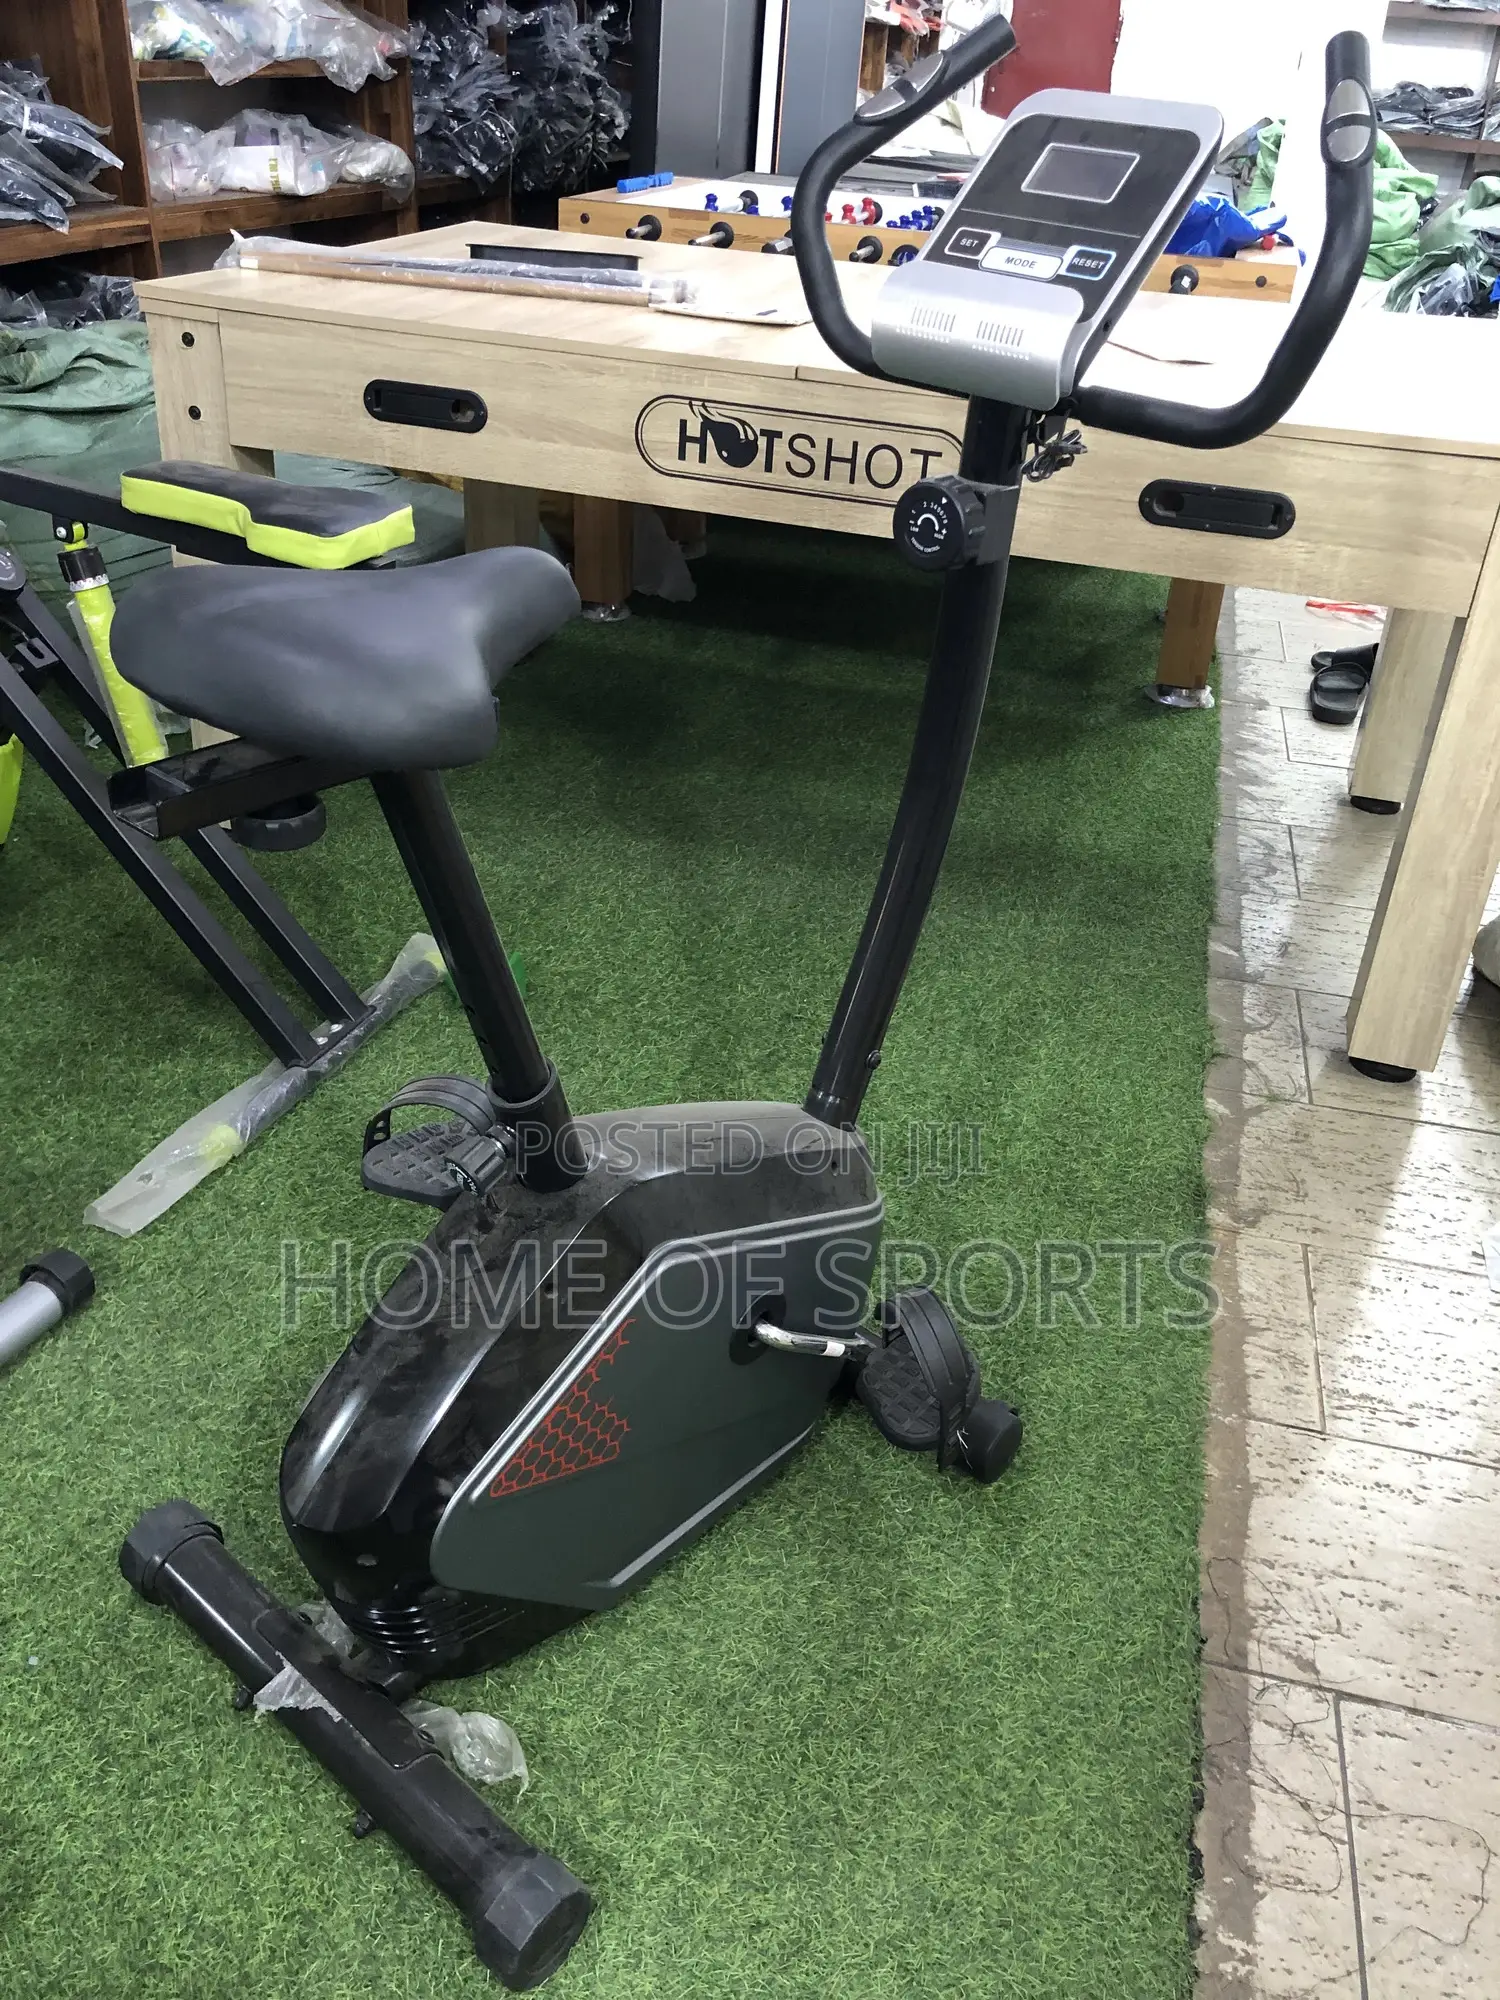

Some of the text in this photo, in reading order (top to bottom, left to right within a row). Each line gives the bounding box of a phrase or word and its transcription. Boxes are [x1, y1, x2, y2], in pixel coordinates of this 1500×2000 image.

[959, 238, 979, 248] SET
[1004, 256, 1038, 269] MODE
[1071, 256, 1106, 270] RESET
